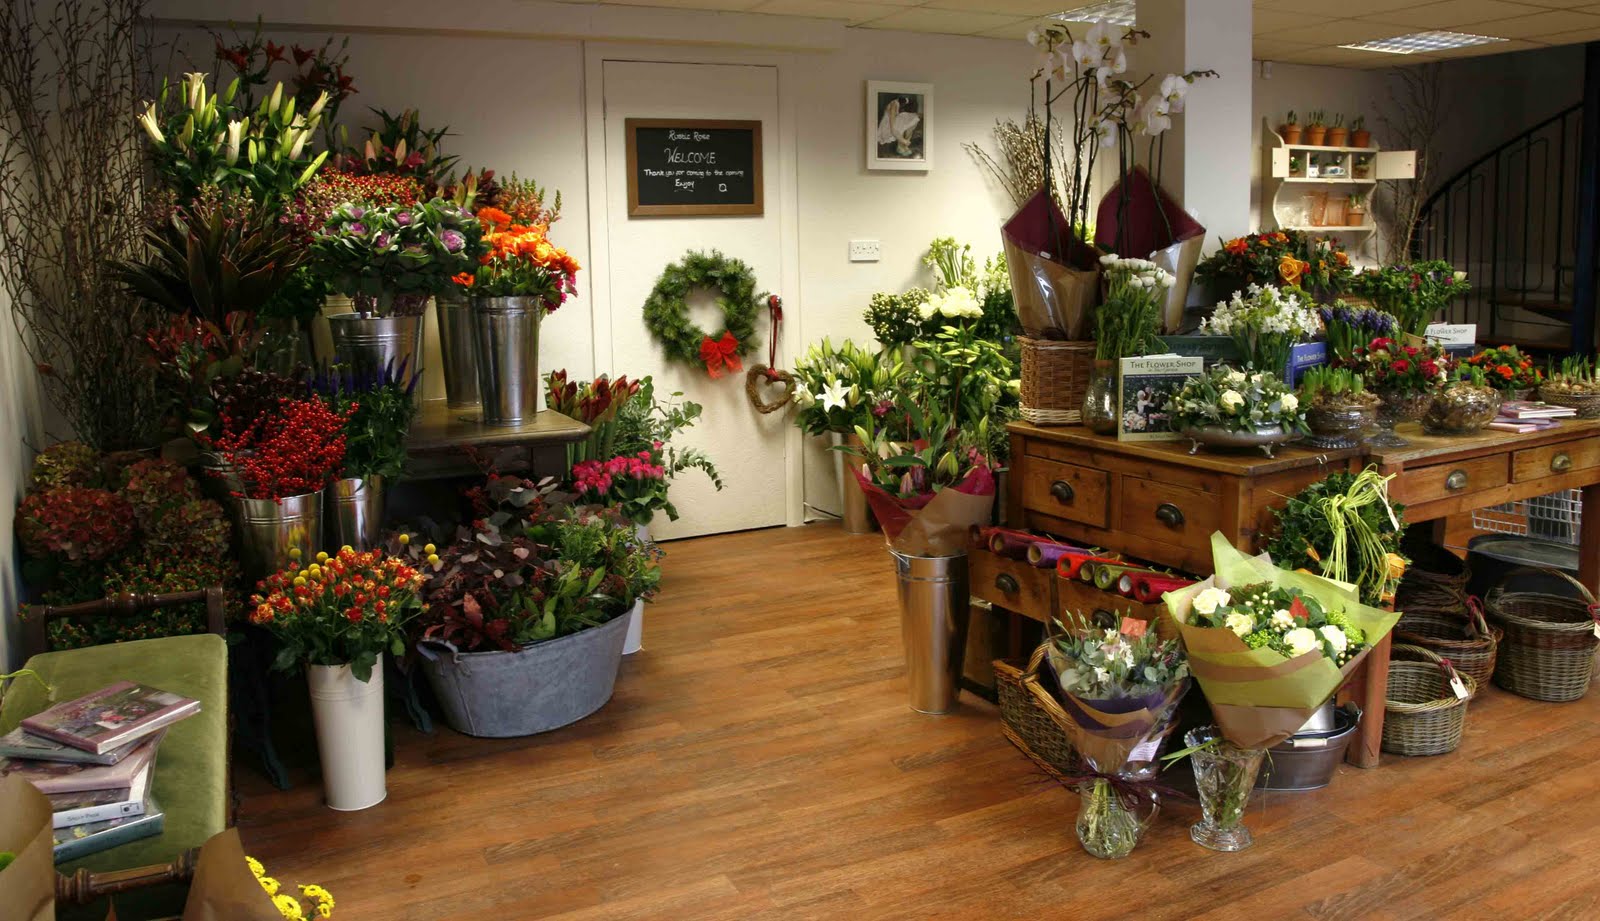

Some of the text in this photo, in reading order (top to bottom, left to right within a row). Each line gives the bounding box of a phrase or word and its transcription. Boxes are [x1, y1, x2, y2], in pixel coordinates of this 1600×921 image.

[664, 146, 716, 164] WELCOME
[643, 168, 664, 176] Thank
[665, 170, 675, 178] you
[675, 178, 695, 189] Enjoy
[1130, 360, 1196, 369] THE FLOWER SHOP
